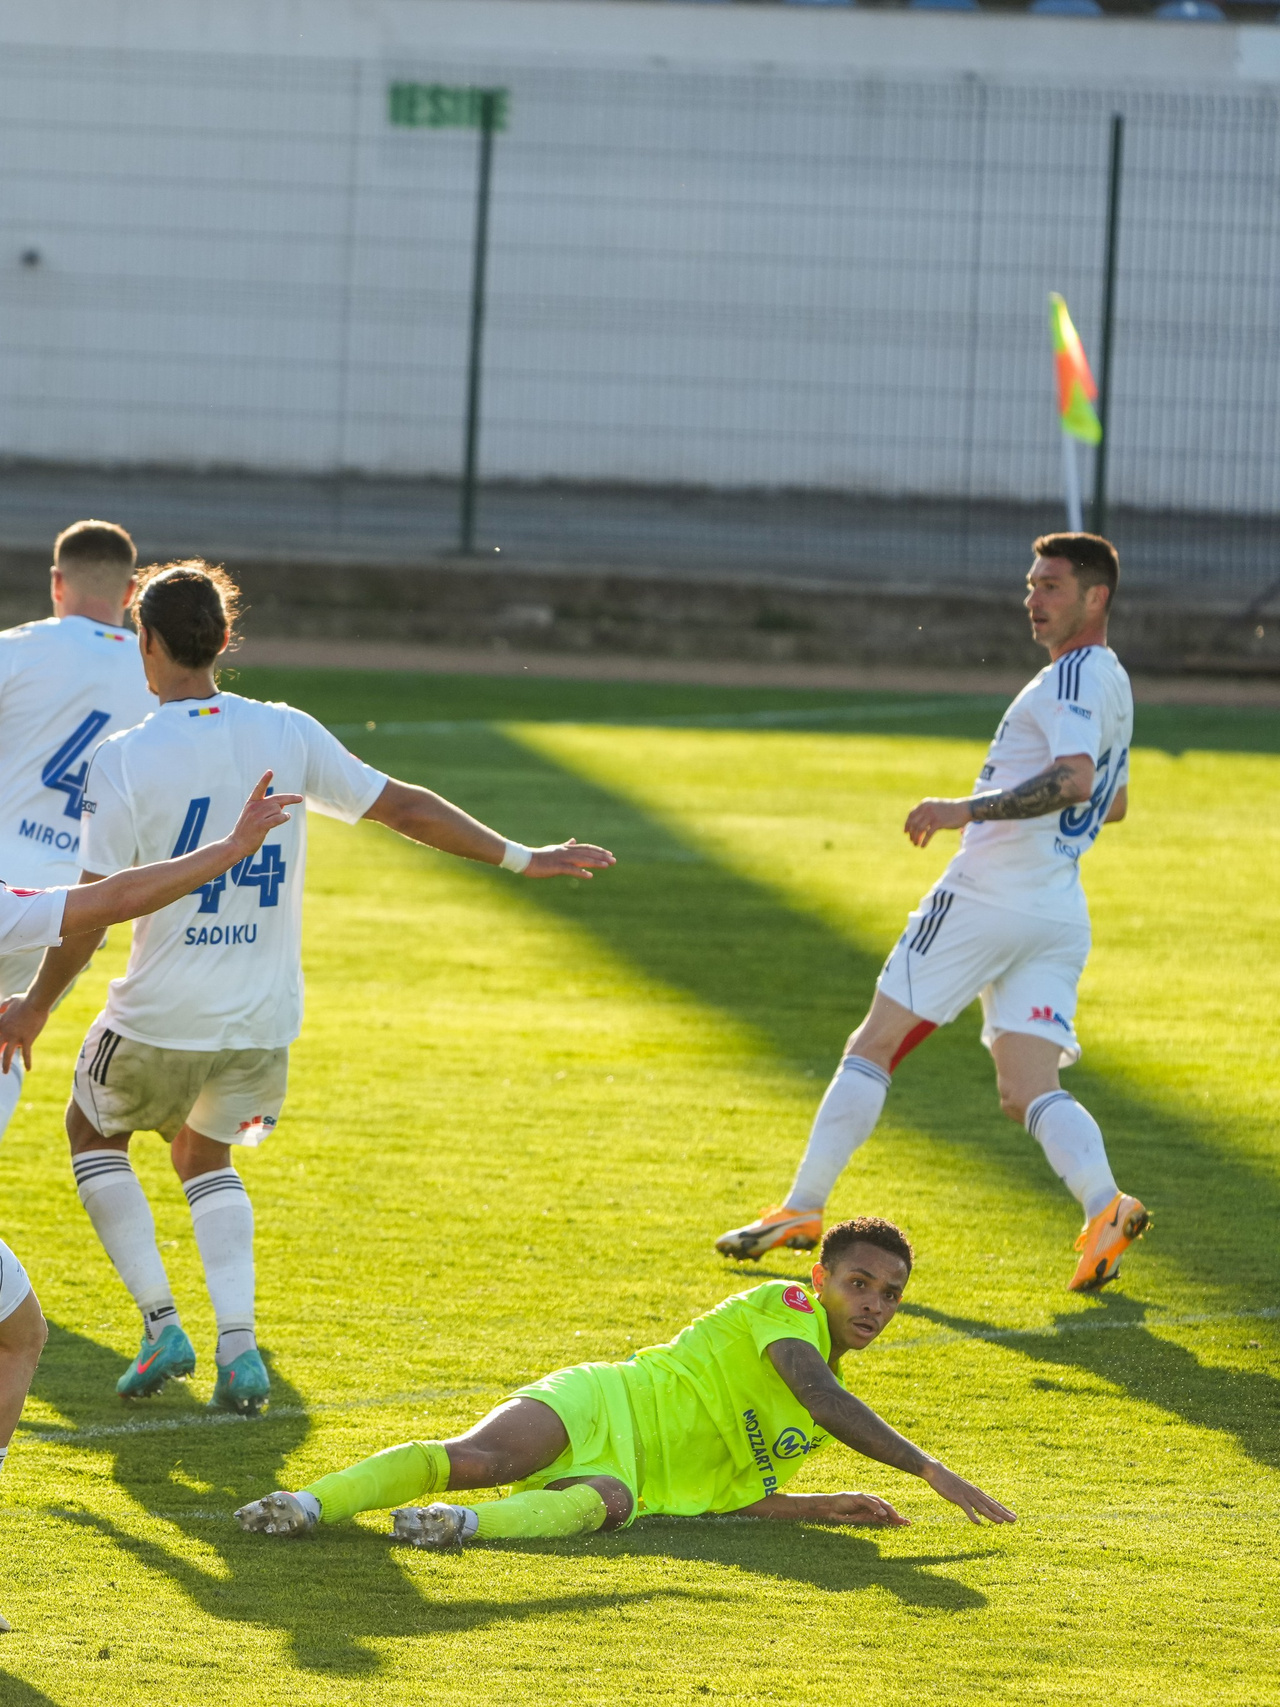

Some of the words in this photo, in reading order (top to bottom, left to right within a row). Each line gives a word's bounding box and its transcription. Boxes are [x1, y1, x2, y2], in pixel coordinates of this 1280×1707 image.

[41, 709, 111, 821] 4
[184, 923, 257, 945] SADIKU
[742, 1408, 774, 1472] MOZZART
